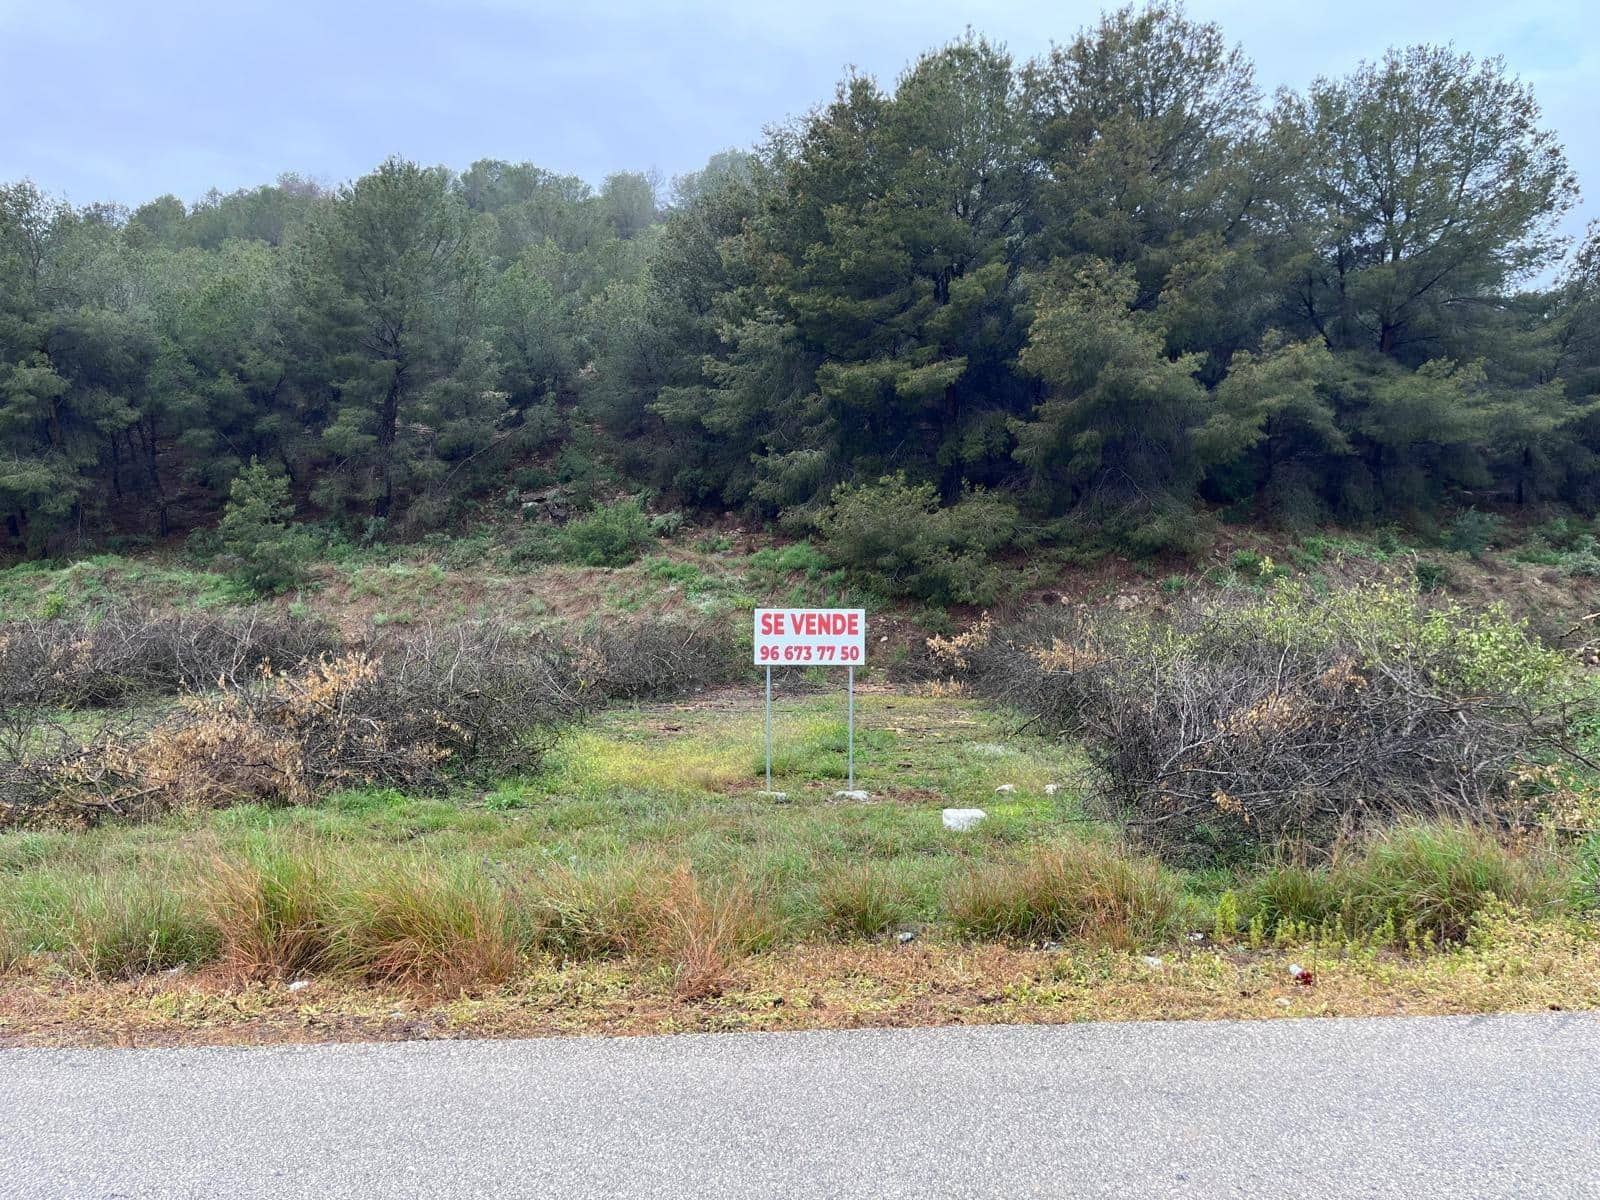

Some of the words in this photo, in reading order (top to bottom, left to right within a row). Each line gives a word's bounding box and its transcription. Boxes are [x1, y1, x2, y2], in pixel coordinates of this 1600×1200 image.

[761, 613, 785, 635] SE
[790, 613, 859, 635] VENDE
[760, 645, 779, 660] 96
[784, 645, 812, 660] 673
[816, 645, 835, 660] 77
[840, 645, 859, 660] 50
